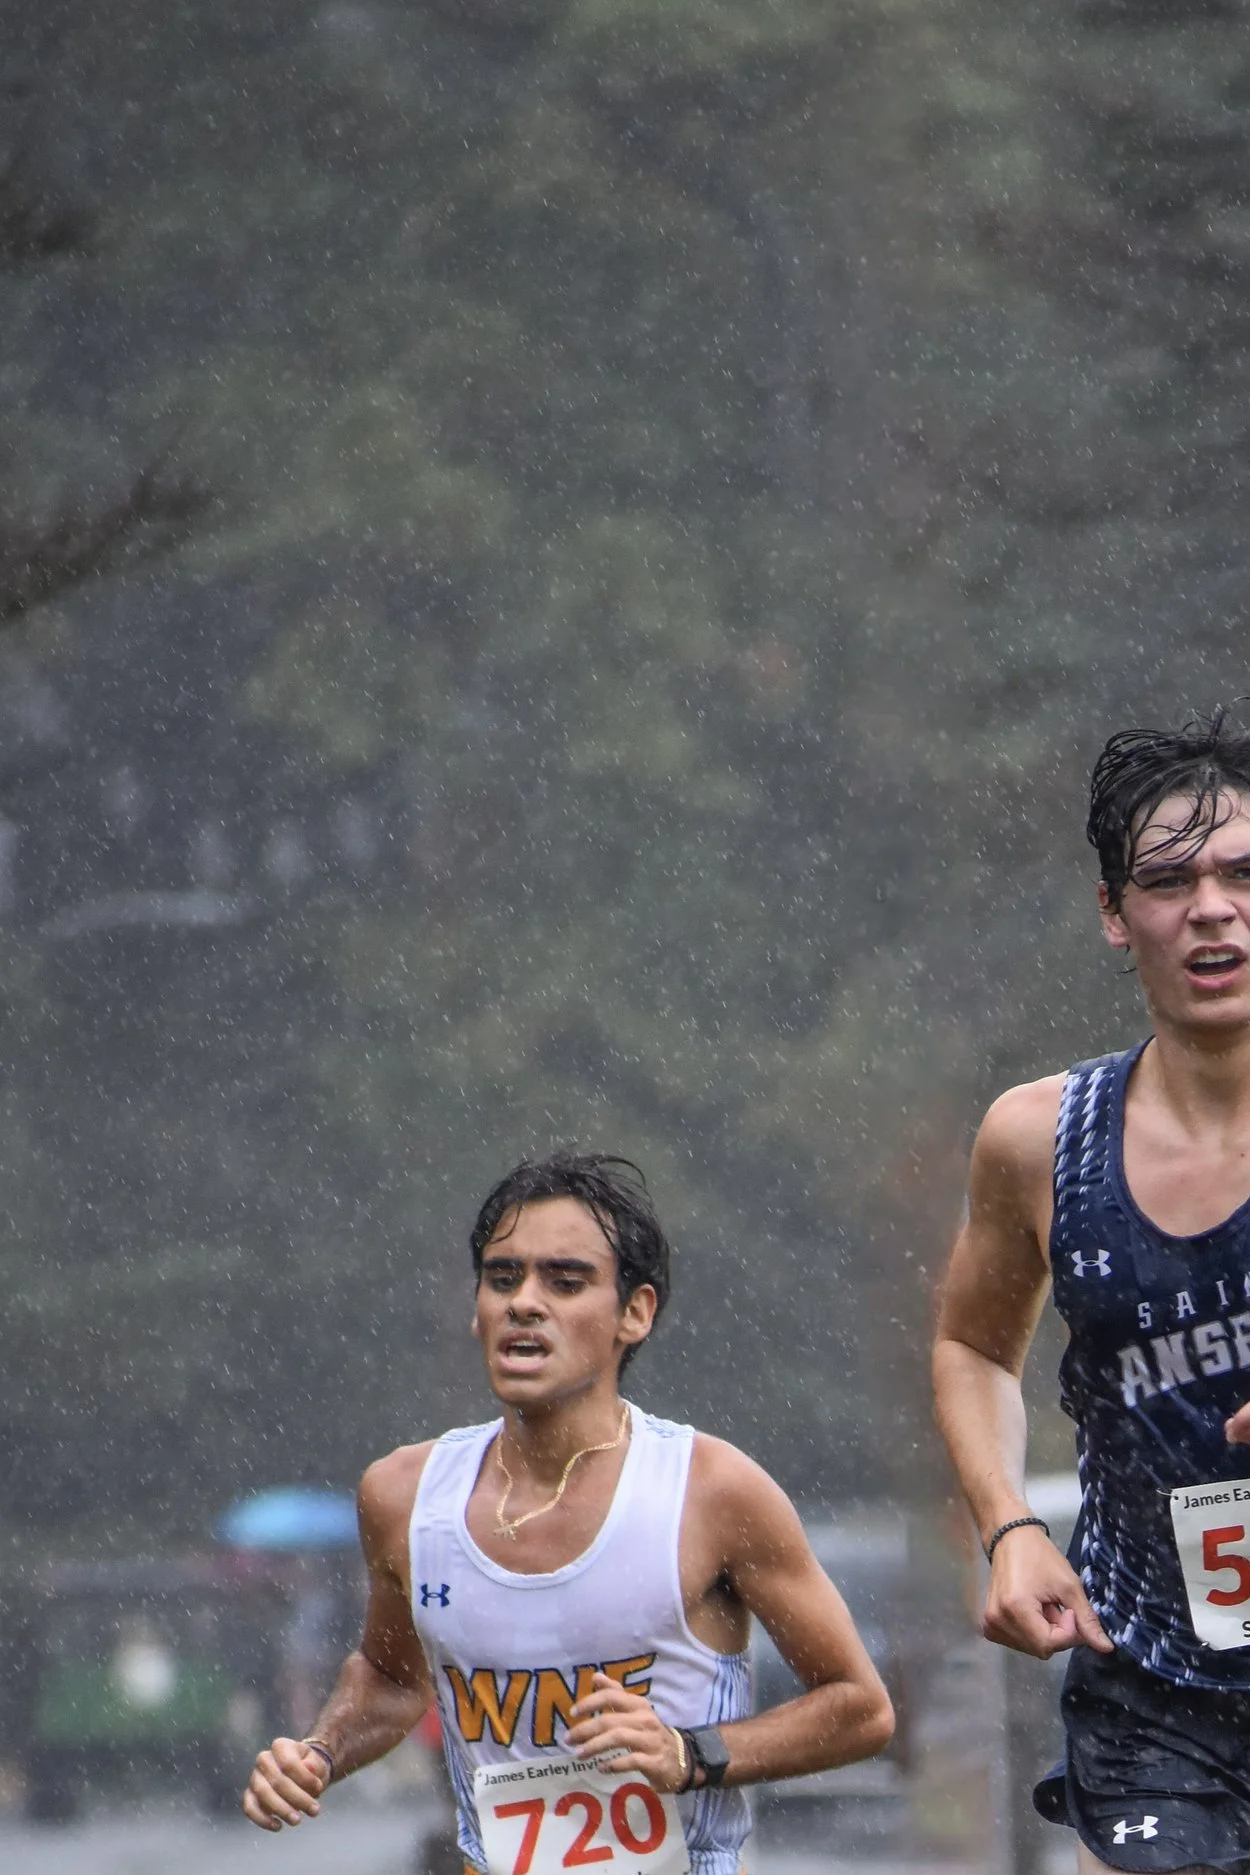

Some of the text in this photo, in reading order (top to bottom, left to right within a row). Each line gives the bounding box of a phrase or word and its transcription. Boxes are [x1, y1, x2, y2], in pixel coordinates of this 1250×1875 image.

[1184, 1493, 1231, 1509] James
[484, 1764, 569, 1786] James Earley
